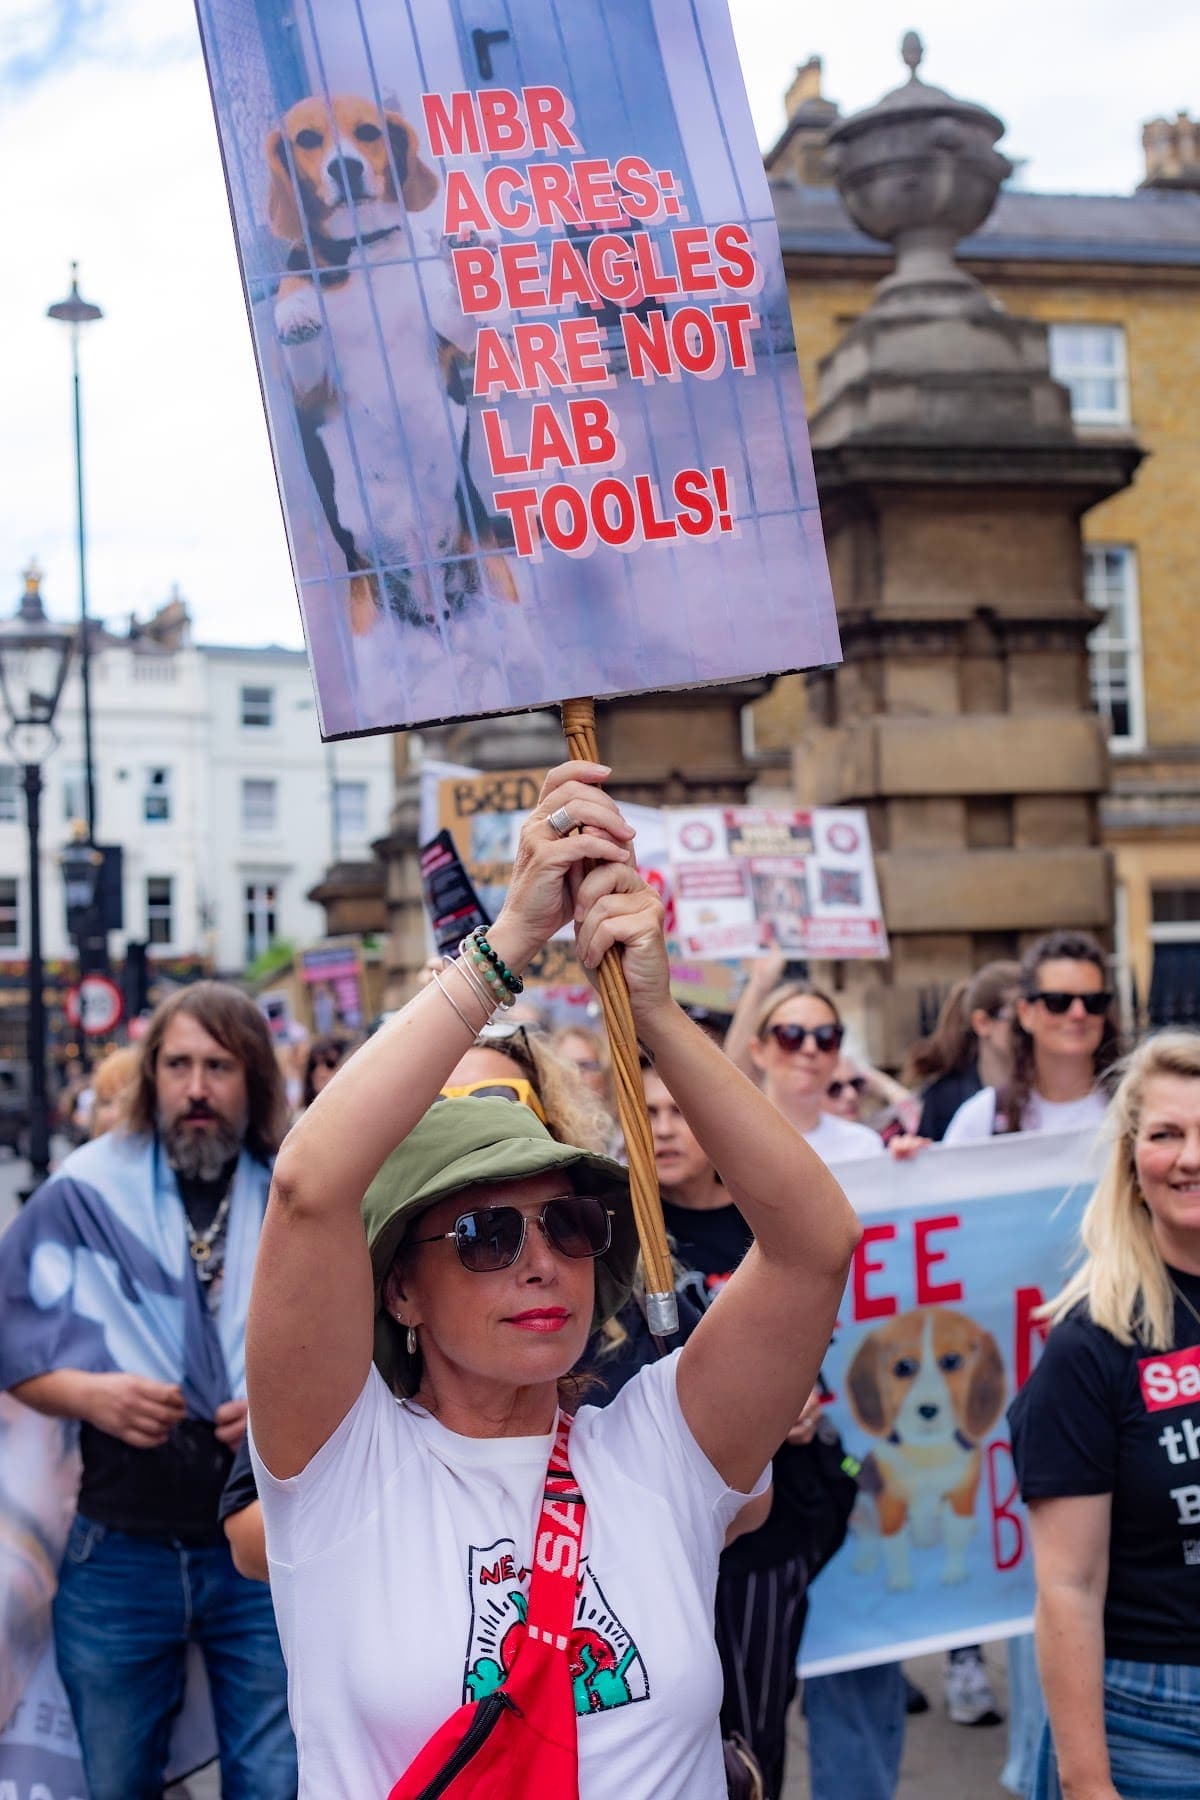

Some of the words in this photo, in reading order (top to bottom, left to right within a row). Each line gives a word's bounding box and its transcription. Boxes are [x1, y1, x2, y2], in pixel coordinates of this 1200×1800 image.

[422, 86, 576, 157] MBR
[443, 156, 681, 236] ACRES:
[451, 224, 757, 315] BEAGLES
[472, 317, 608, 396] ARE
[619, 302, 753, 380] NOT
[480, 398, 618, 477] LAB
[494, 466, 734, 558] TOOLS!
[853, 1214, 963, 1323] EE
[1143, 1361, 1200, 1402] Sa
